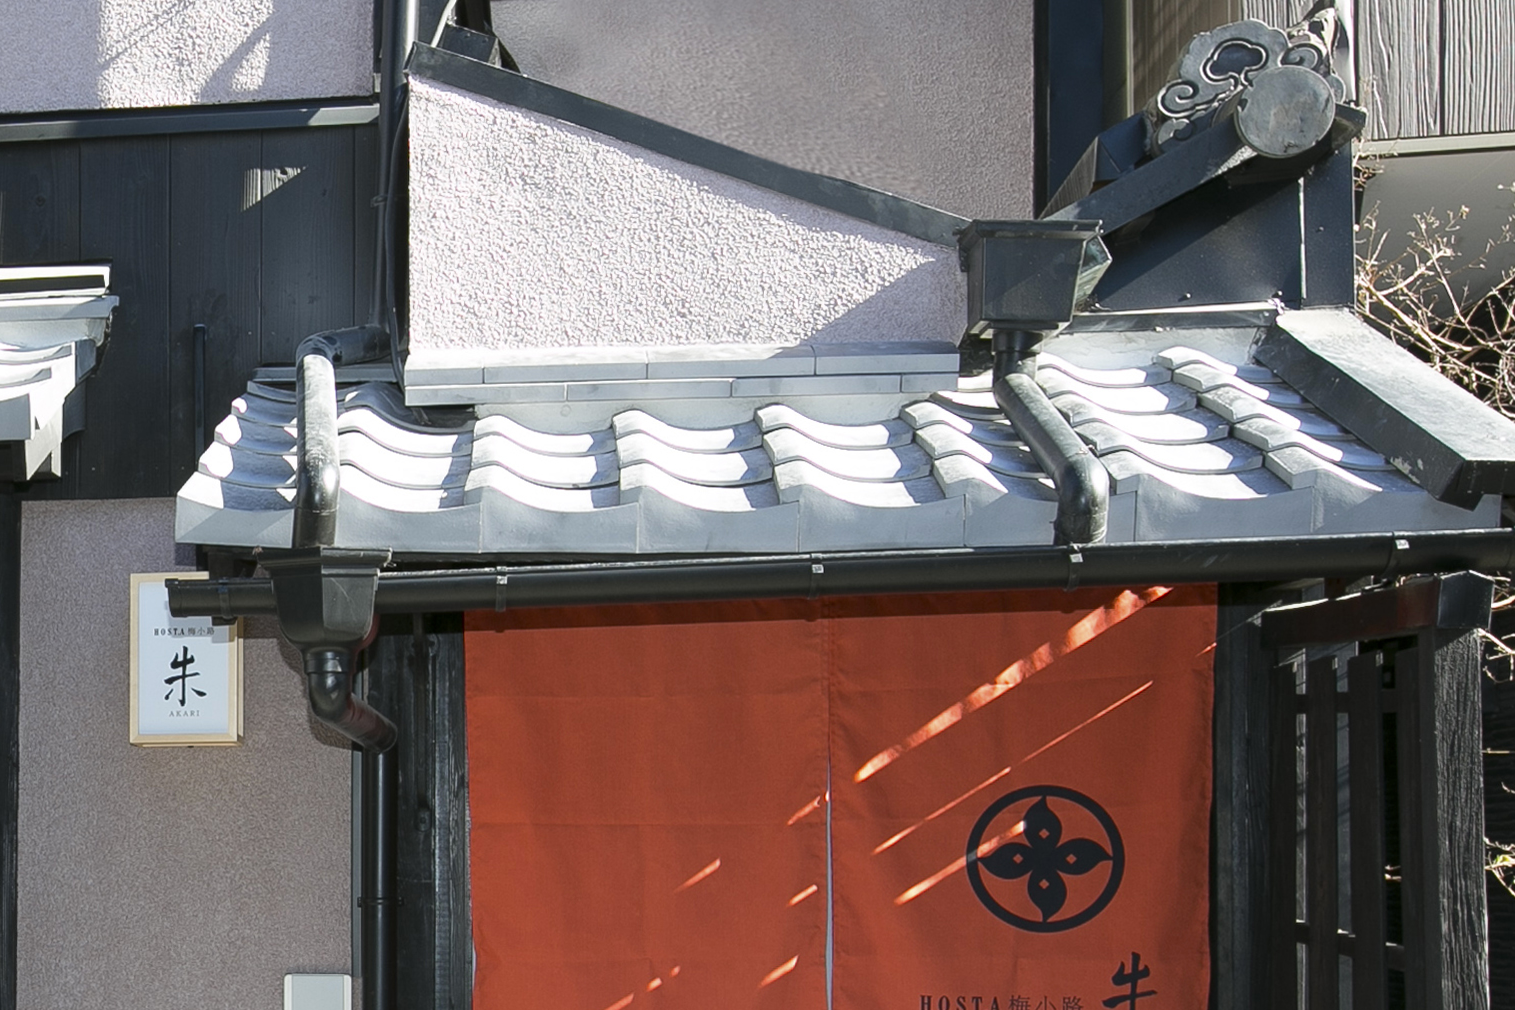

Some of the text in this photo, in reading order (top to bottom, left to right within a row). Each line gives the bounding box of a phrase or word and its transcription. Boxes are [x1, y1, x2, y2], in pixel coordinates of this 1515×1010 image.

[187, 627, 215, 636] 梅小路
[164, 645, 207, 707] 朱
[169, 710, 200, 718] AKARI
